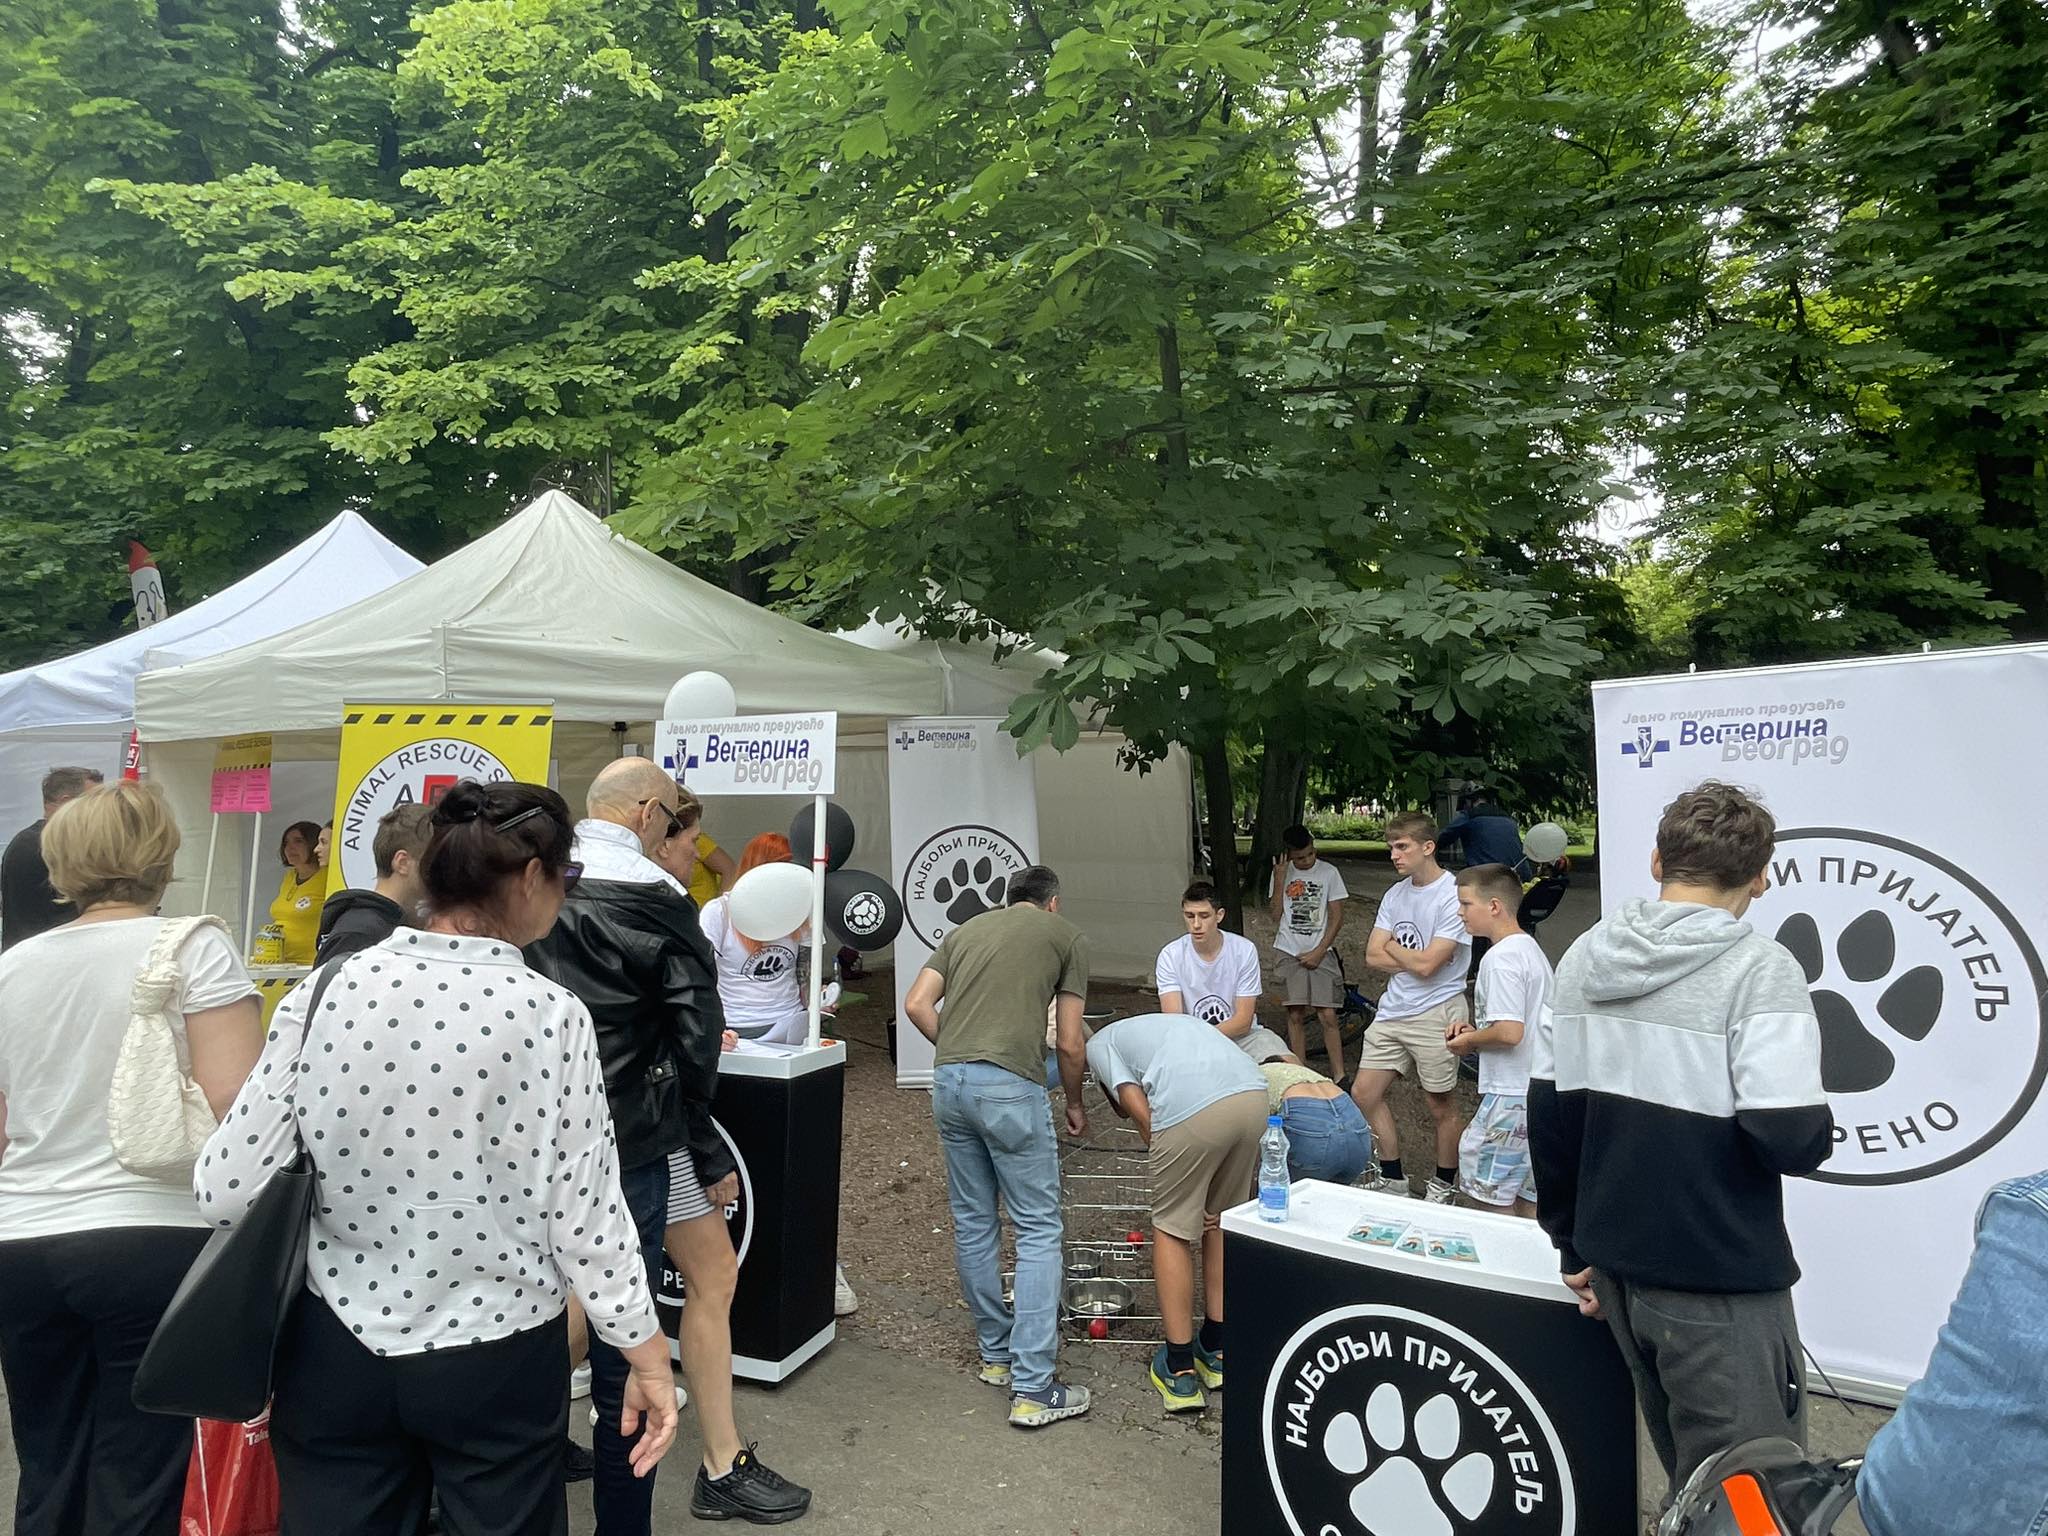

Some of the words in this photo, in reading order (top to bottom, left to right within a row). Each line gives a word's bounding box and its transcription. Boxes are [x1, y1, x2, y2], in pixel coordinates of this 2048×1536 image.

[667, 722, 698, 735] Јавно
[700, 720, 761, 735] комунално
[763, 717, 824, 734] предузеће
[1622, 712, 1666, 724] Јавно
[1670, 706, 1755, 722] комунално
[1758, 699, 1846, 717] предузеће
[705, 734, 810, 763] Ветерина
[1679, 718, 1828, 746] Ветерина
[1721, 735, 1849, 766] Београд
[734, 754, 824, 791] Београд
[344, 766, 396, 851] ANIMAL
[398, 743, 490, 773] RESCUE
[914, 836, 963, 900] НАЈБОЉИ
[967, 836, 1019, 871] ПРИЈАТ
[1819, 856, 2010, 1022] ПРИЈАТЕЉ
[1285, 1331, 1393, 1448] НАЈБОЉИ
[1403, 1335, 1544, 1514] ПРИЈАТЕЉ
